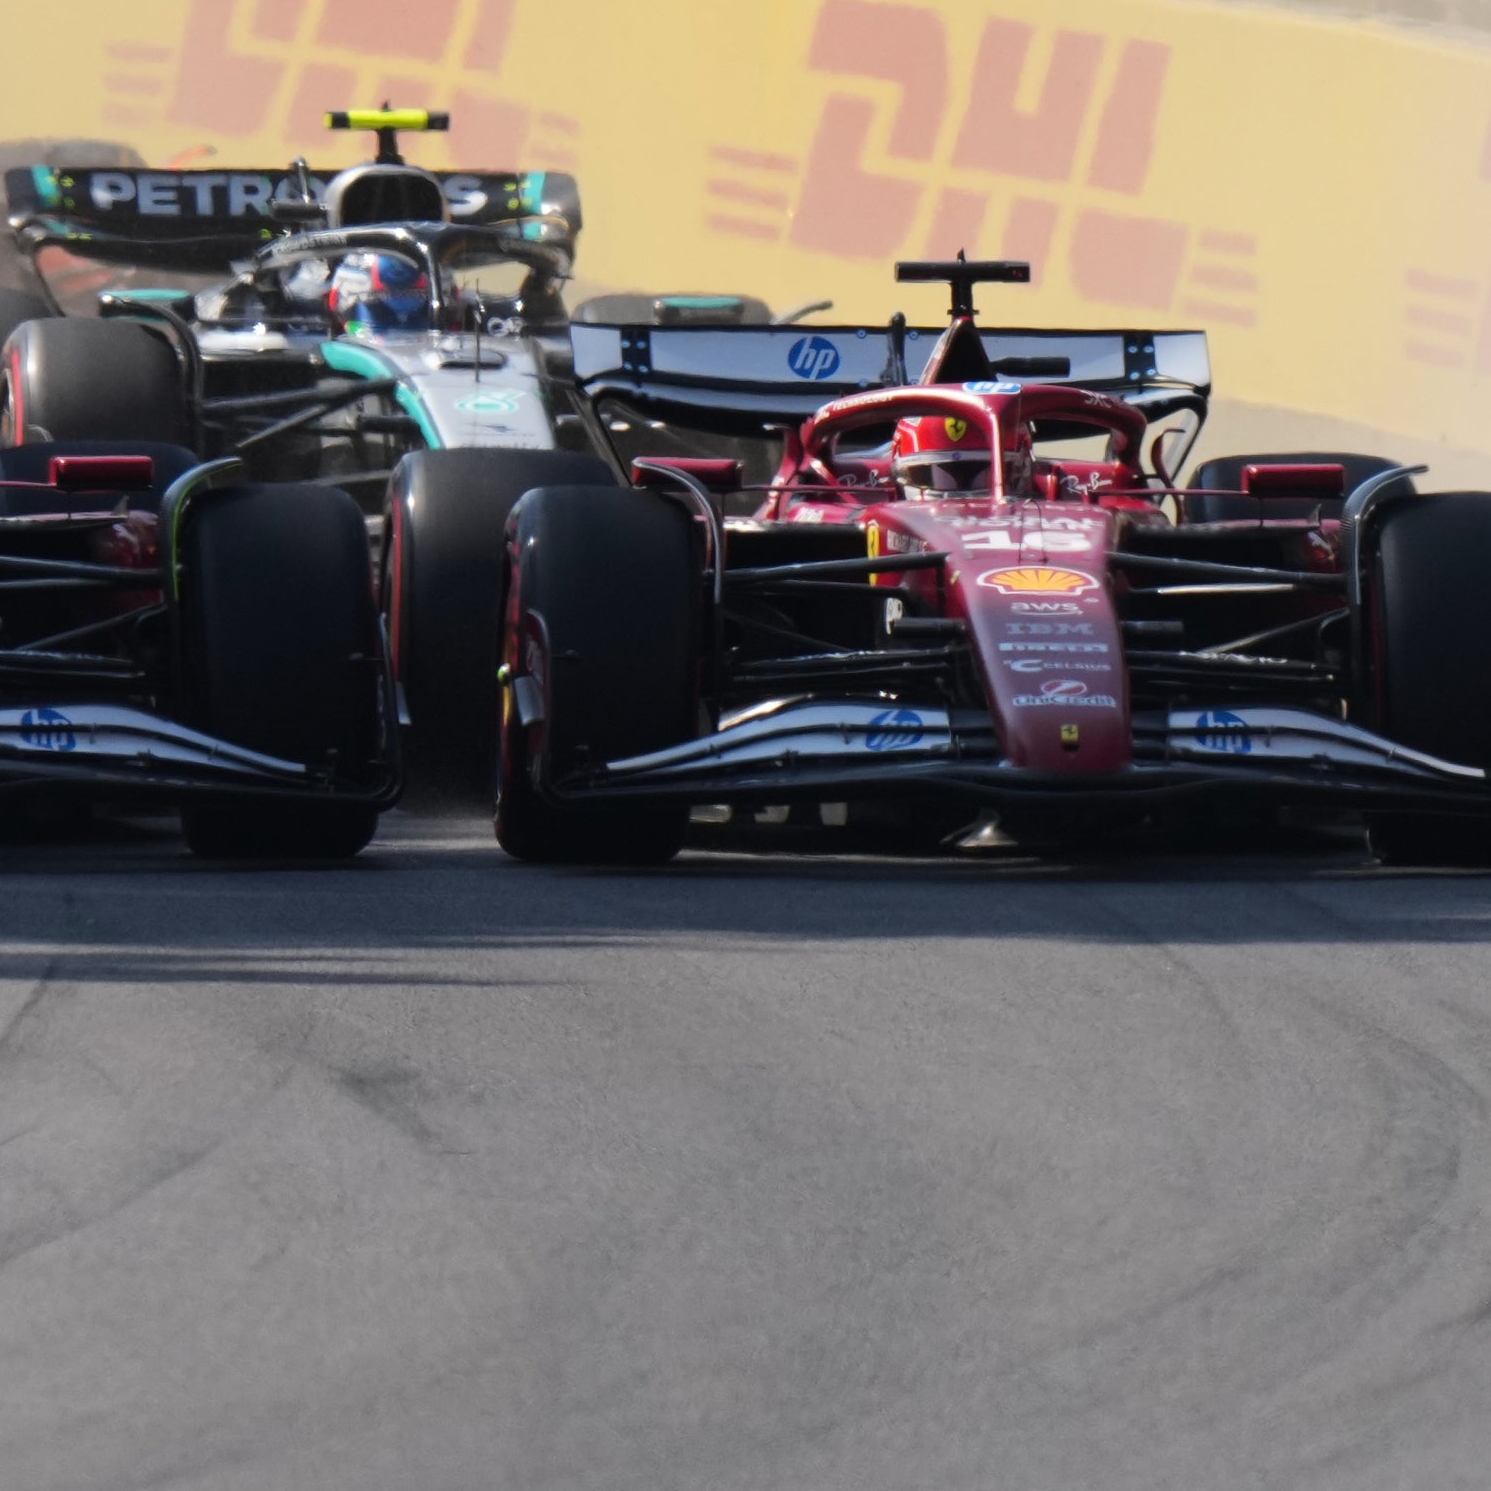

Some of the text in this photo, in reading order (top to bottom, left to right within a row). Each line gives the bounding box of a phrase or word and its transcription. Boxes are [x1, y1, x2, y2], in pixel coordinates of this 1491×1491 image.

[89, 170, 489, 217] PETROS
[792, 336, 837, 380] hp
[1060, 470, 1113, 494] Ray-Ban
[961, 529, 1092, 552] 16
[1011, 601, 1079, 611] aws
[1007, 622, 1094, 636] IBM
[29, 709, 75, 751] hp
[870, 708, 920, 751] hp
[1201, 710, 1250, 753] hp
